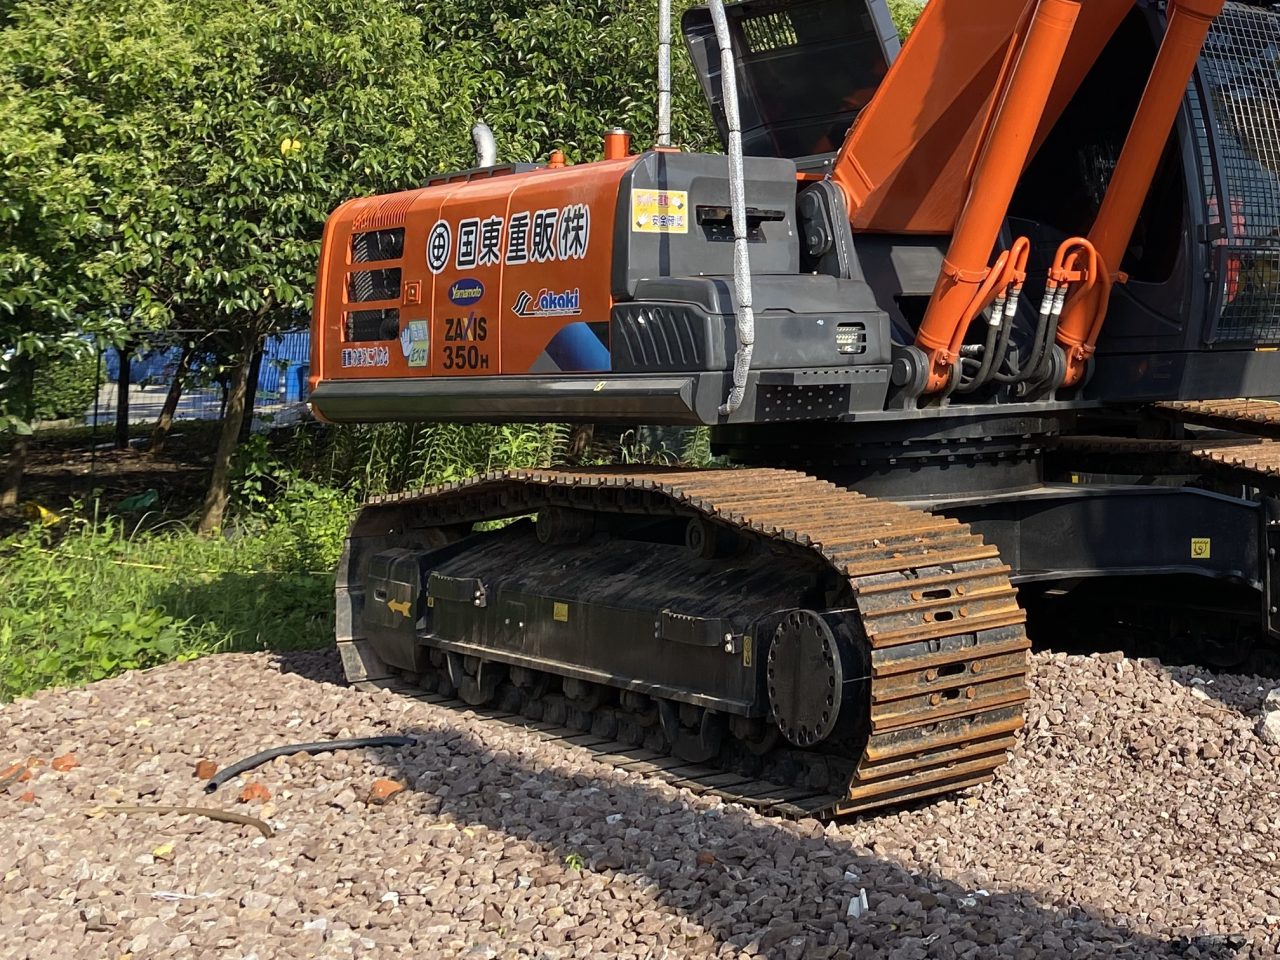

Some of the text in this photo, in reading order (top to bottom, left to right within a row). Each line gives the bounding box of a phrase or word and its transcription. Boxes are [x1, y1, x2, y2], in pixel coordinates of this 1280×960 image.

[457, 205, 590, 267] 国東重販(株)
[452, 284, 482, 299] Yamamoto
[533, 288, 579, 309] Sakaki
[445, 312, 488, 342] ZAXIS
